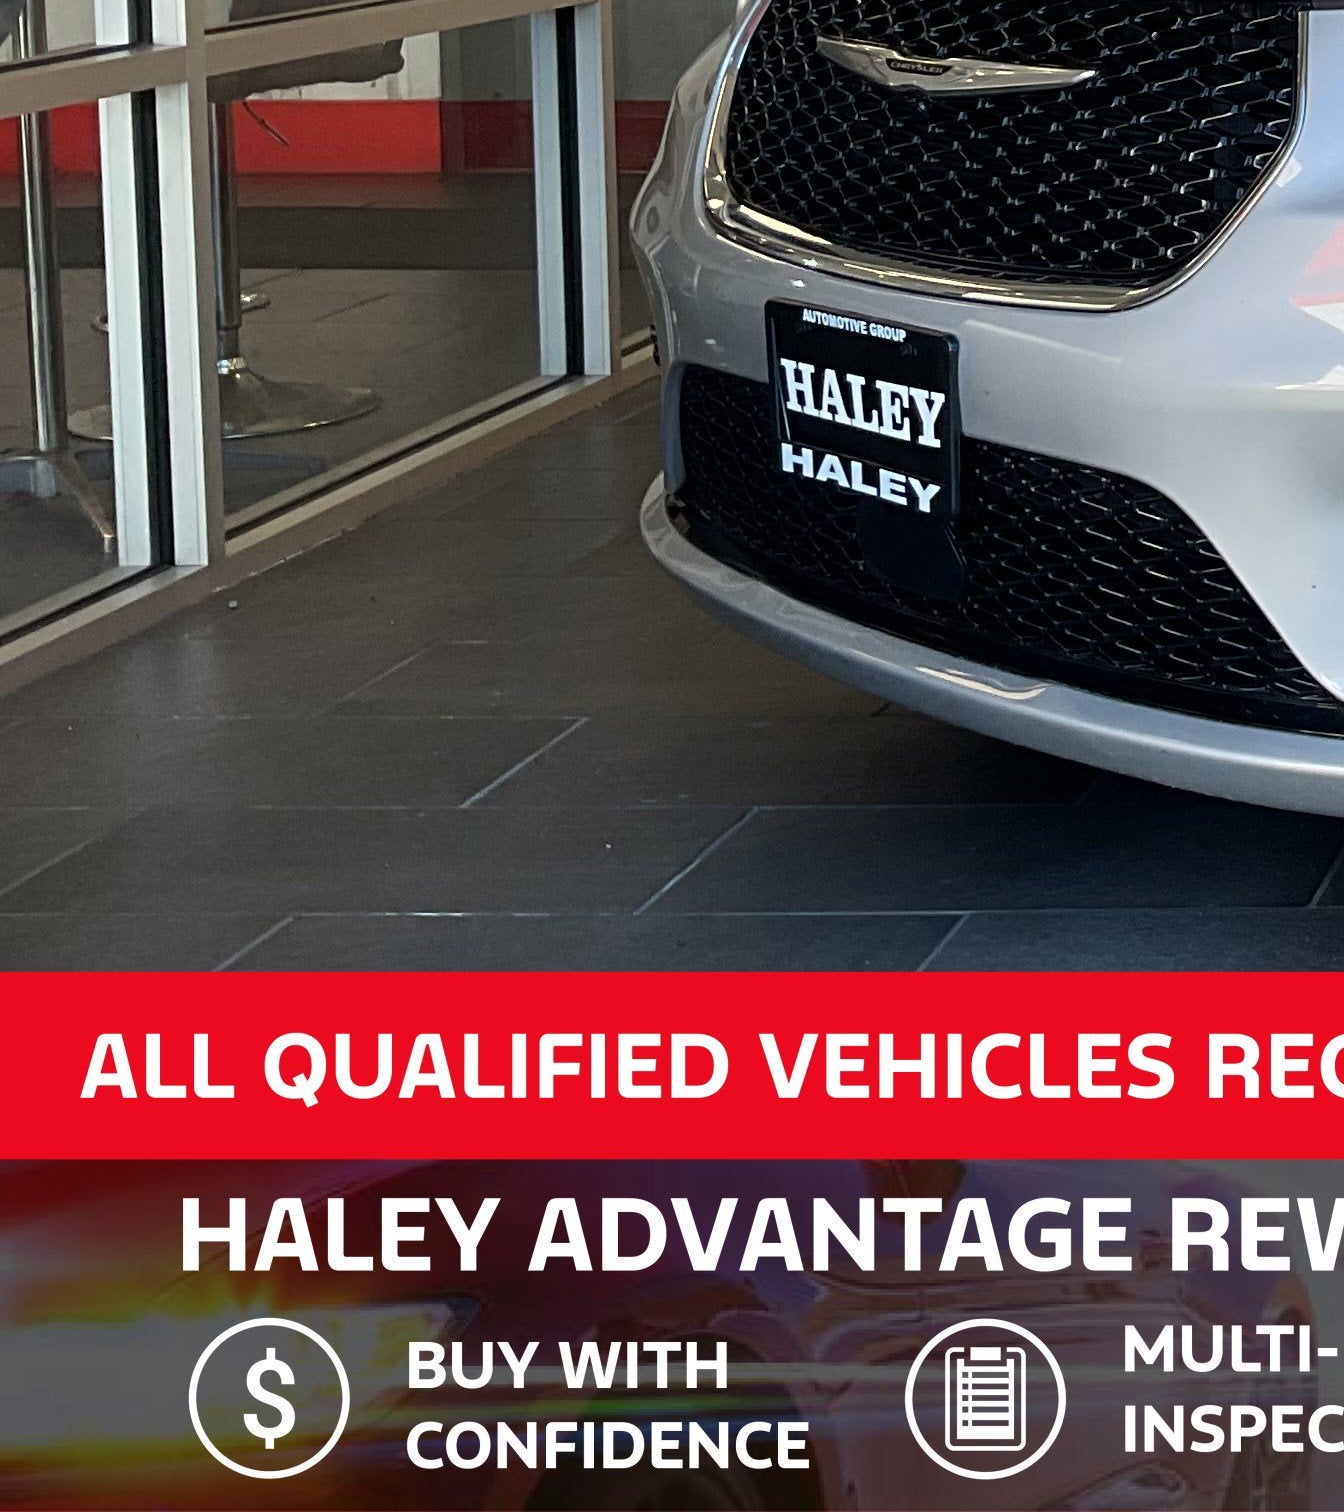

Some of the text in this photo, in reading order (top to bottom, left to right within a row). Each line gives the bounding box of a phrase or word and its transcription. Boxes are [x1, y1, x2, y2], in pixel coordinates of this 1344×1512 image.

[802, 308, 907, 343] AUTOMOTIVE GROUP
[780, 357, 945, 448] HALEY
[781, 442, 941, 513] HALEY
